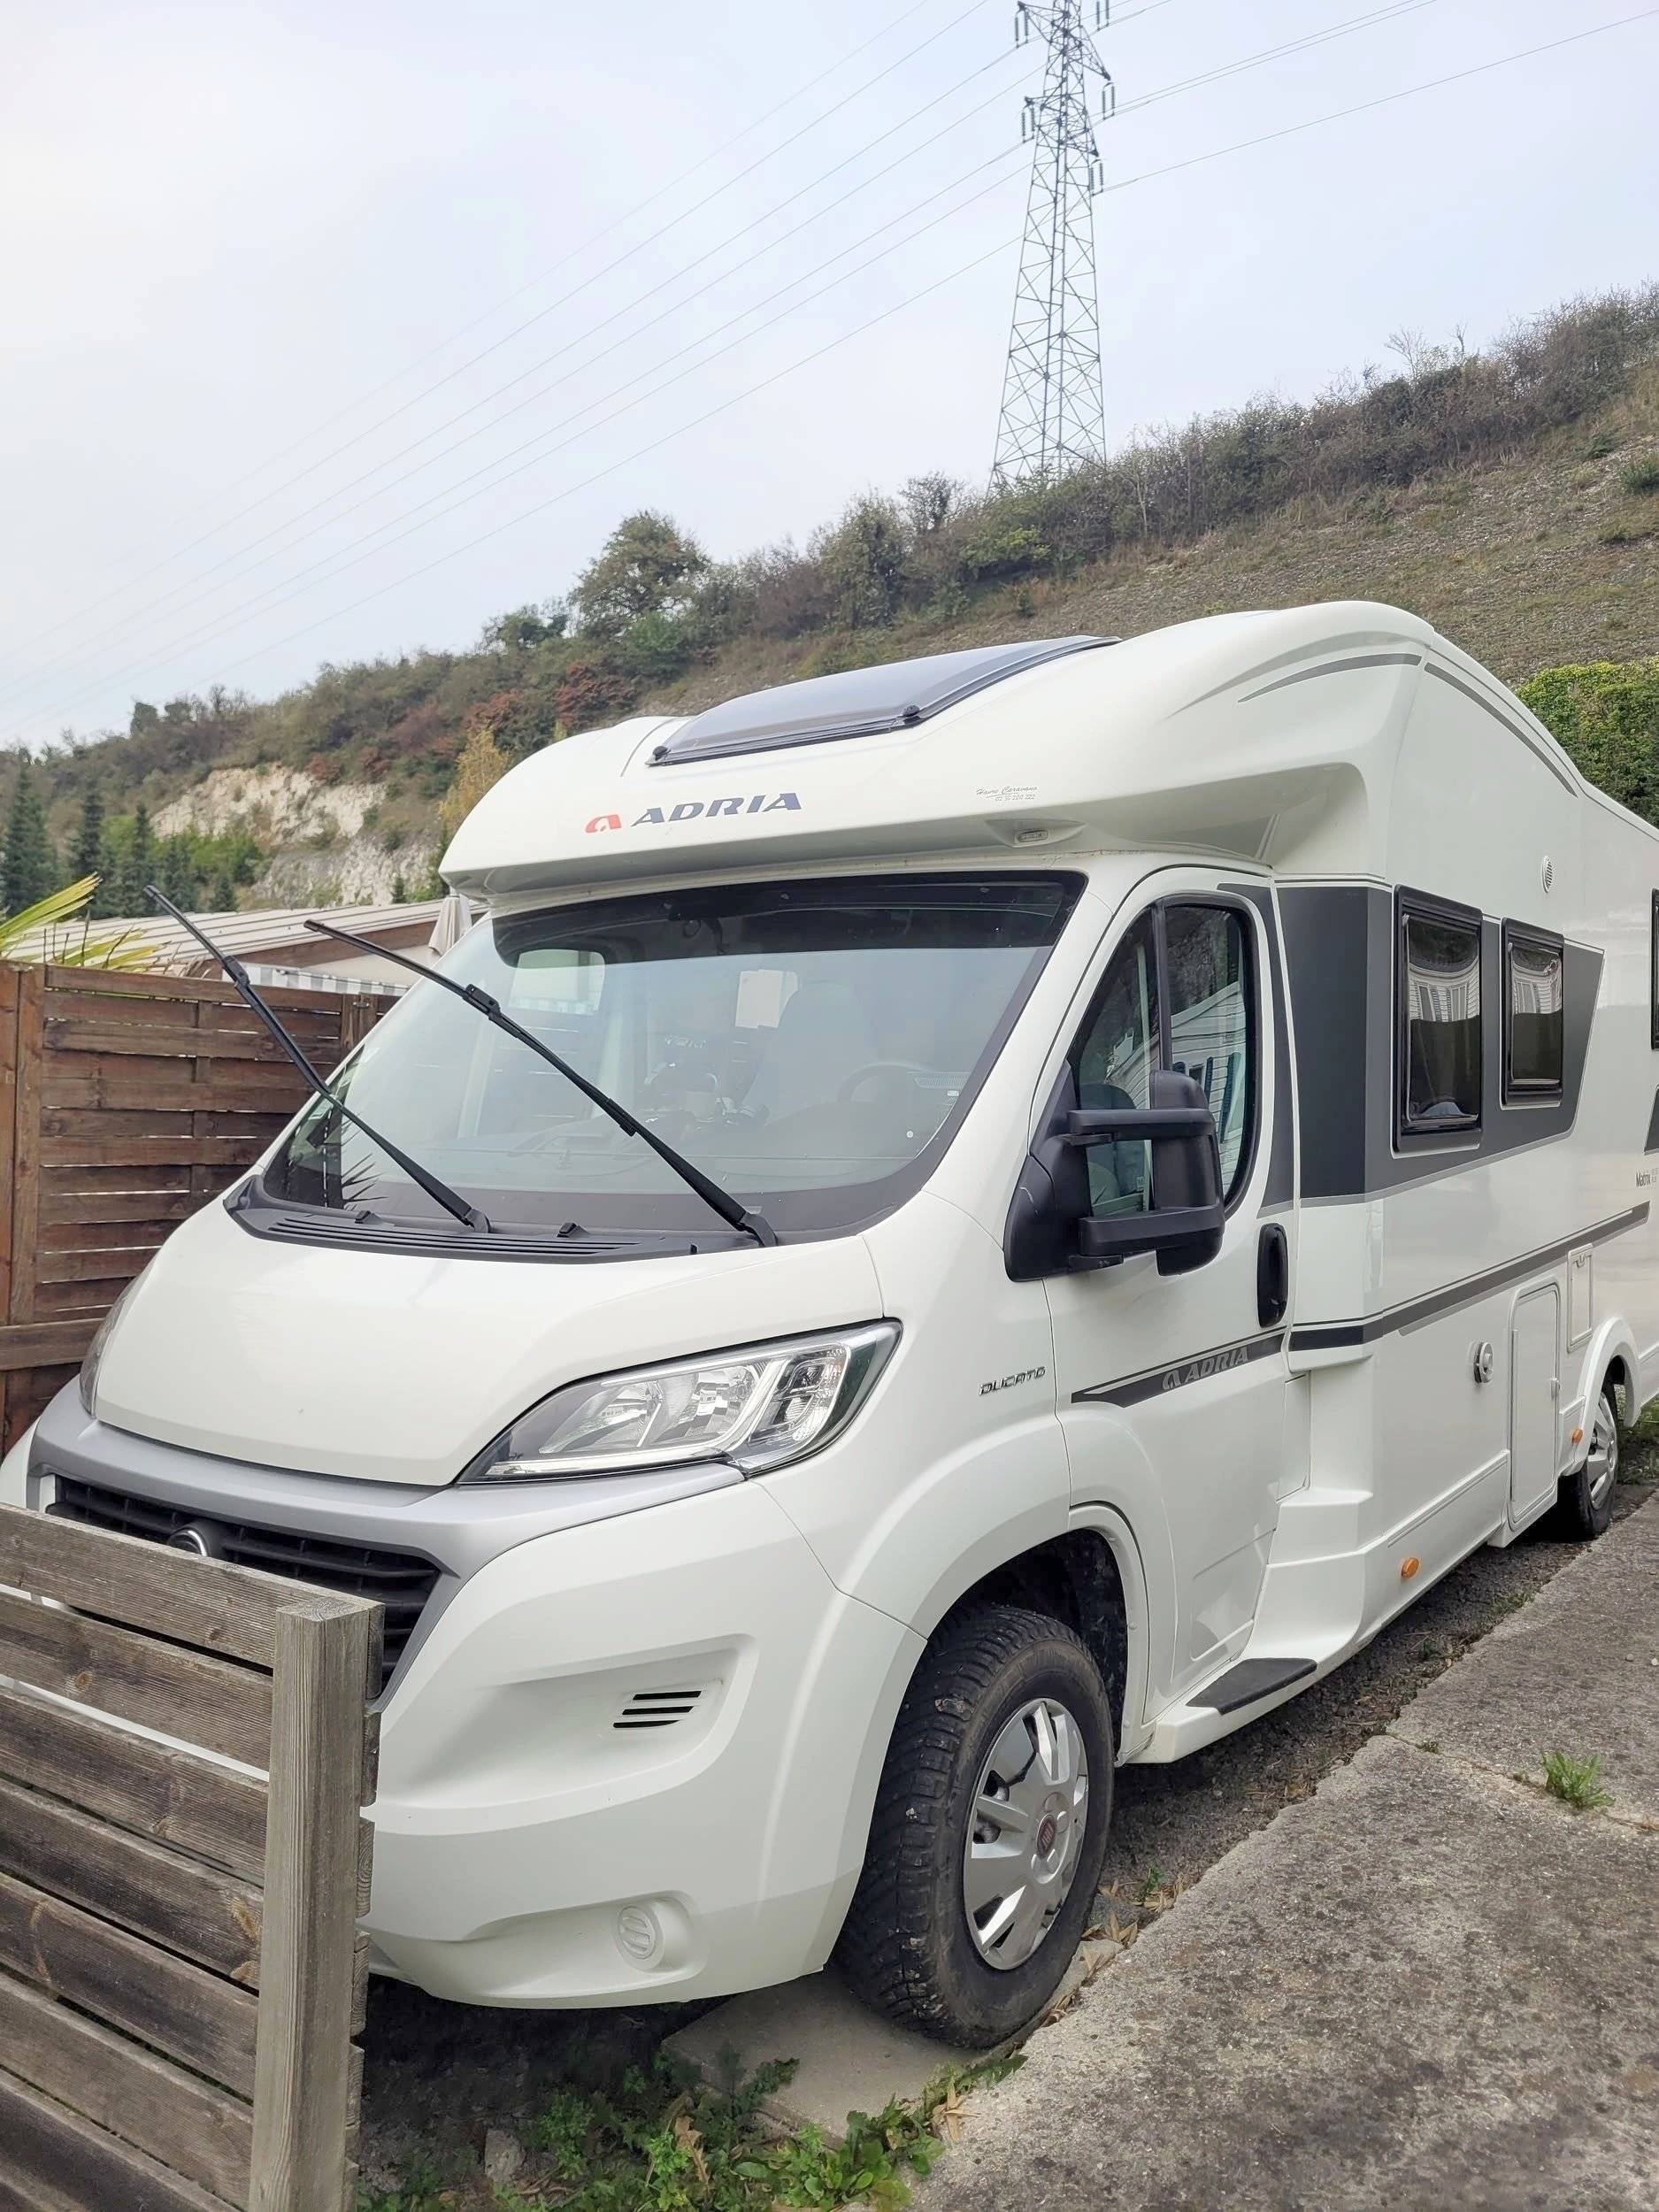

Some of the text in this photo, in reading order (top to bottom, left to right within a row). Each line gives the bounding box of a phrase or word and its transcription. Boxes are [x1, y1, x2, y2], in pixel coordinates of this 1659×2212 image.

[630, 793, 802, 827] ADRIA
[979, 1365, 1046, 1395] DUCATO
[1185, 1346, 1248, 1384] ADRIA
